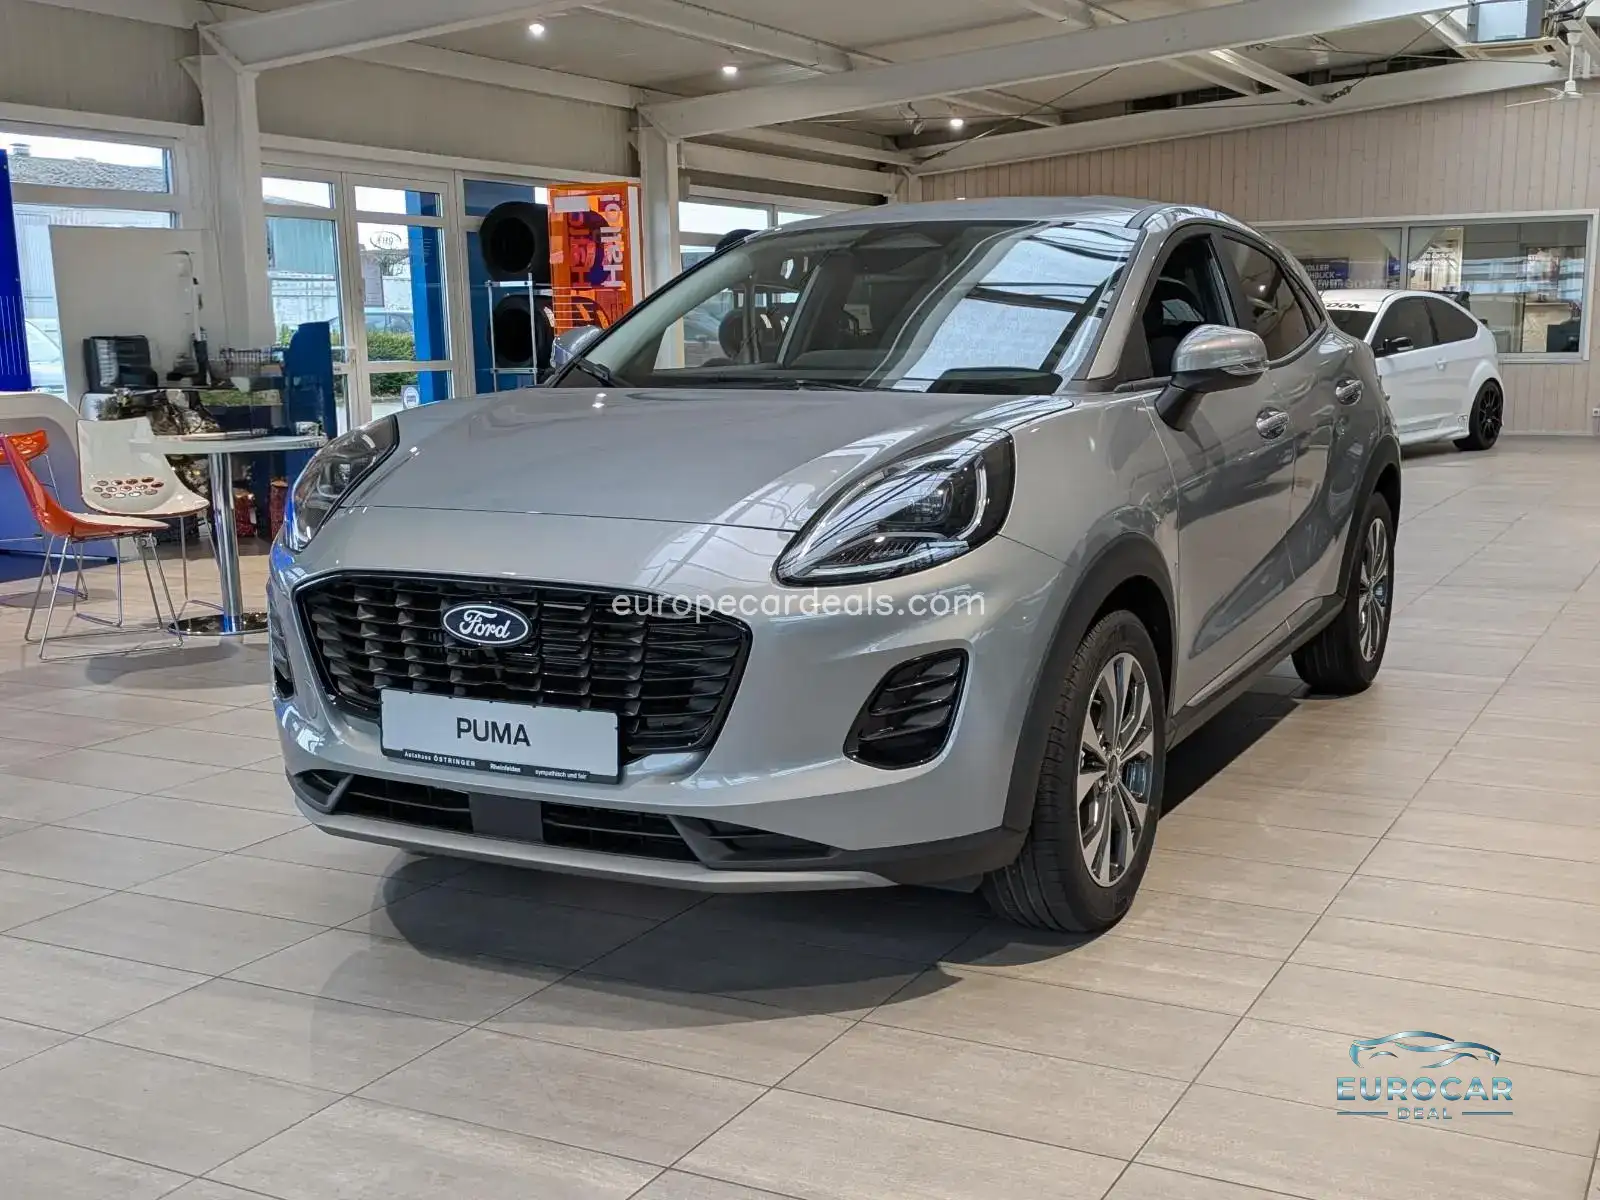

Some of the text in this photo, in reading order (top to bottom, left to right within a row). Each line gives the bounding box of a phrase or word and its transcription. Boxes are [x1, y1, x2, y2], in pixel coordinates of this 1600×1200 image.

[459, 609, 511, 638] Ford
[456, 717, 531, 747] PUMA
[433, 755, 476, 767] ÖSTRINGER
